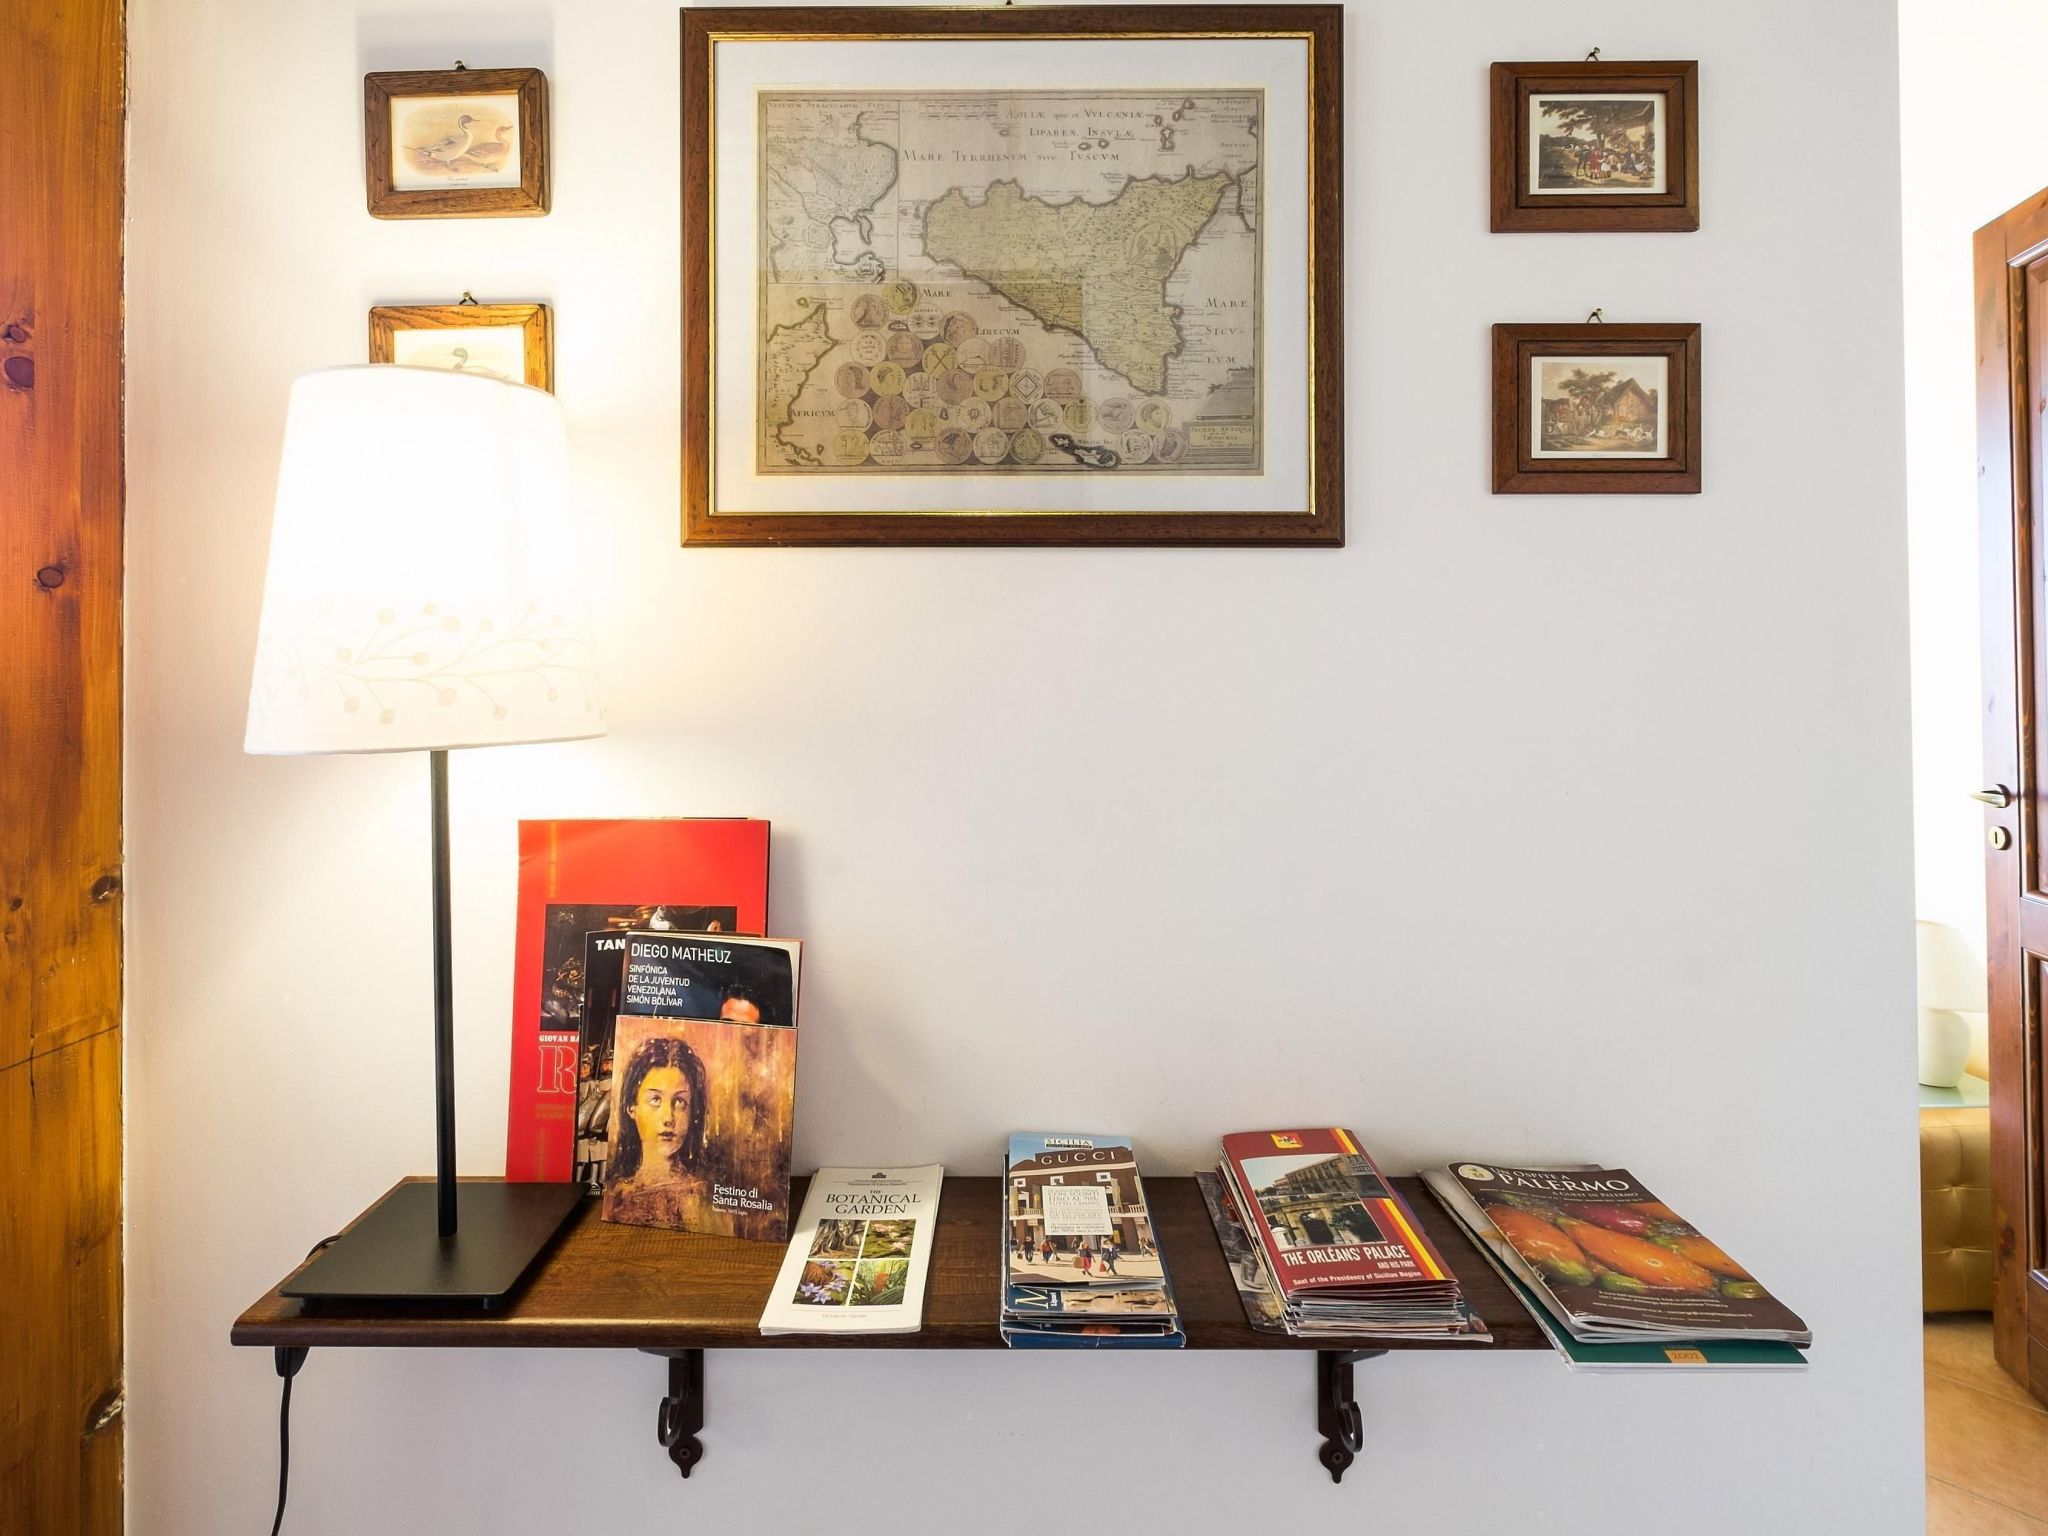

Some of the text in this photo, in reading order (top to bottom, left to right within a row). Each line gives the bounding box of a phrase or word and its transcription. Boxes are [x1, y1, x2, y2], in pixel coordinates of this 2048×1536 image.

[595, 938, 626, 951] TAN
[631, 943, 732, 964] DIEGO MATHEUZ
[629, 963, 668, 975] SINFÓNICA
[628, 974, 690, 987] DE LA JUVENTUD
[627, 985, 676, 996] VENEZOLANA
[626, 994, 683, 1007] SIMÓN BOLÍVAR
[539, 1034, 568, 1042] GIOVAN
[1041, 1151, 1115, 1165] GUCCI
[1498, 1173, 1629, 1192] PALERMO
[713, 1184, 758, 1198] Festino di
[712, 1194, 738, 1207] Santa
[741, 1198, 773, 1211] Rosalia
[826, 1193, 922, 1204] BOTANICAL
[835, 1204, 907, 1214] GARDEN
[1281, 1245, 1410, 1266] THE ORLÉANS' PALACE
[1292, 1278, 1308, 1286] Seat
